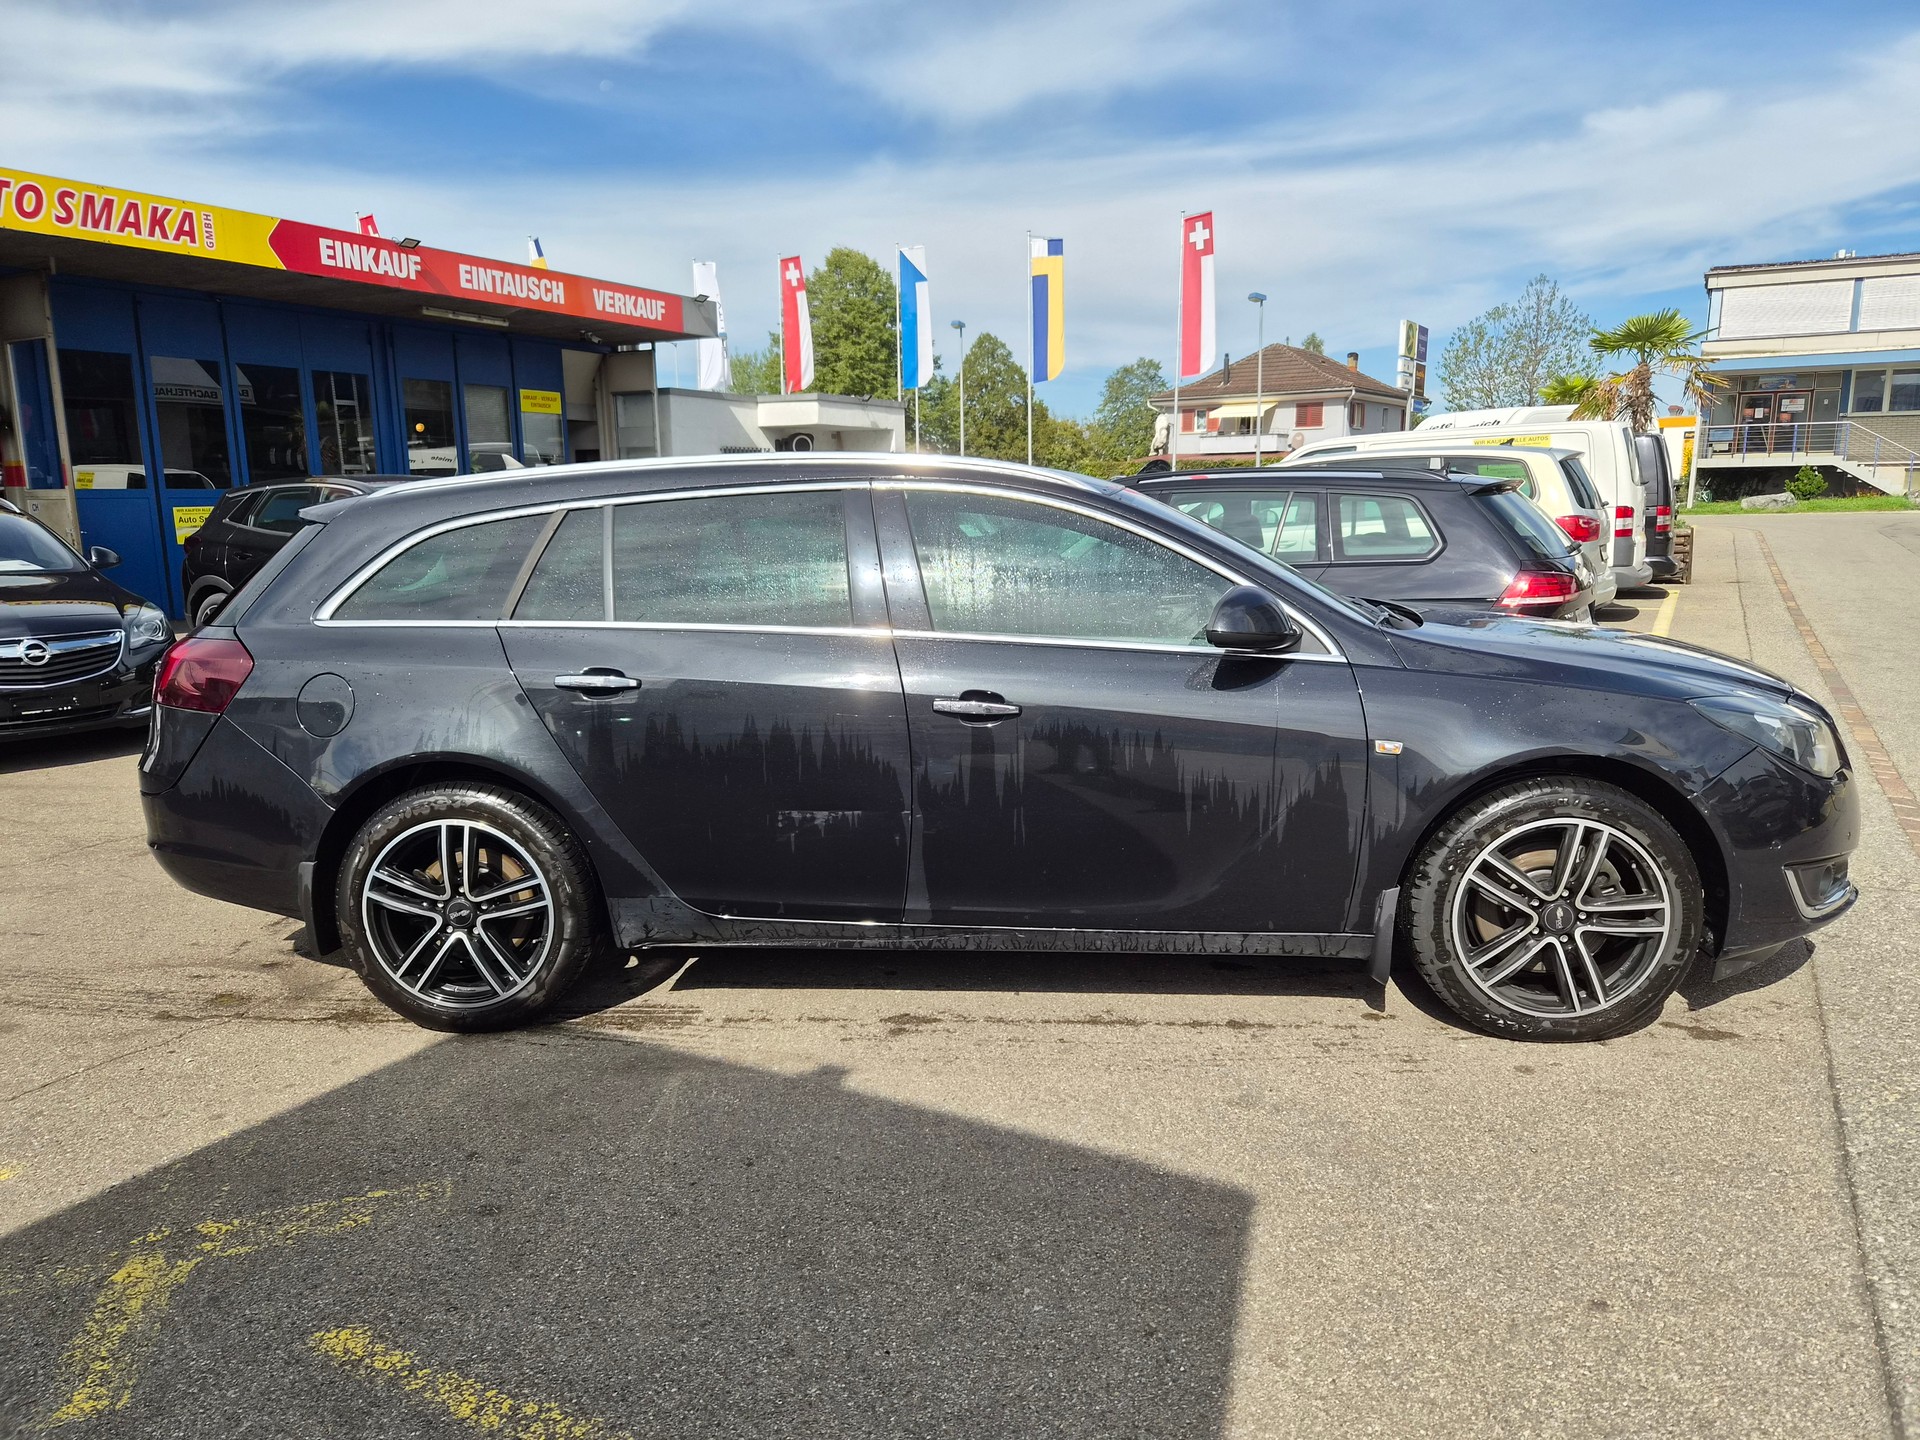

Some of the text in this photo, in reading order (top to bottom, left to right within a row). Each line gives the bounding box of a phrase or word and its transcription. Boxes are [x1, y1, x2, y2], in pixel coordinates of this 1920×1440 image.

[55, 190, 197, 245] SMAKA
[203, 213, 215, 248] GMBH
[319, 237, 666, 321] EINKAUF EINTAUSCH VERKAUF
